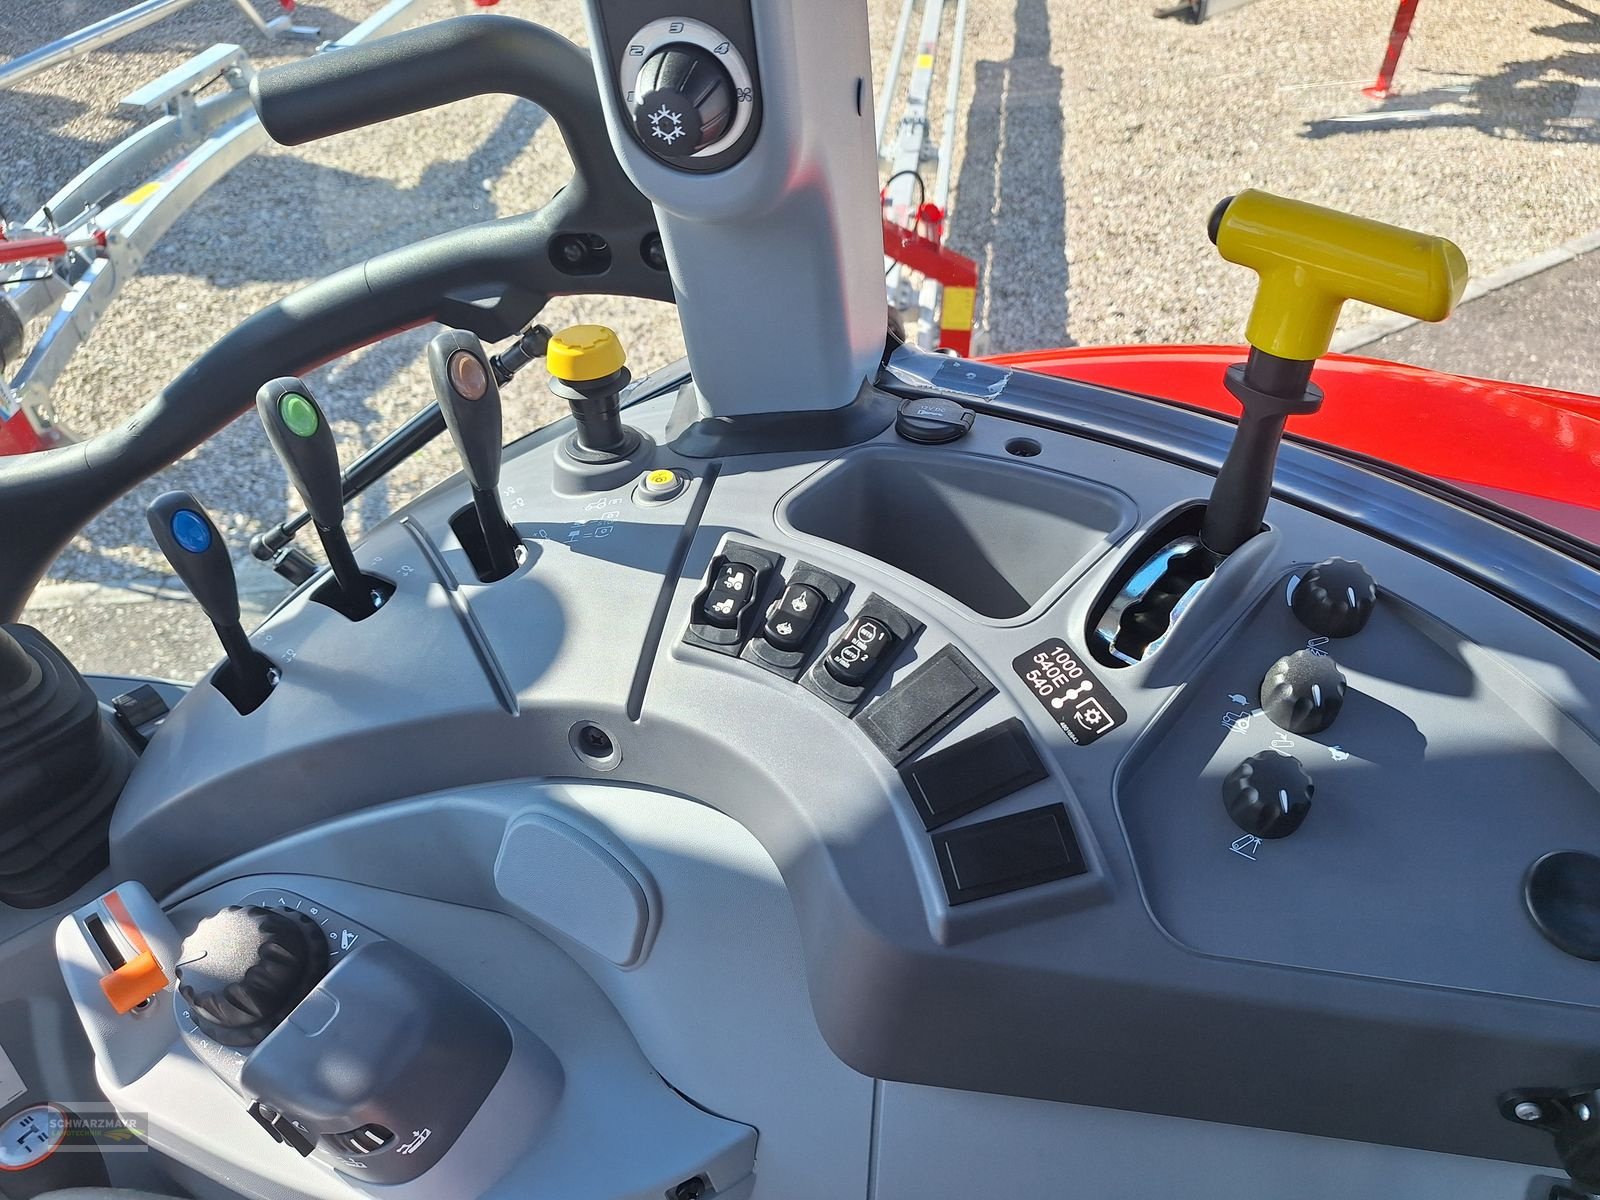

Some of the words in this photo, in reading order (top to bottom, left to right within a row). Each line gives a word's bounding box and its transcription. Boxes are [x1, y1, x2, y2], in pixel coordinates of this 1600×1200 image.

[669, 22, 684, 33] 3
[629, 45, 644, 56] 2
[714, 42, 729, 54] 4
[726, 567, 733, 575] A
[878, 632, 885, 640] 1
[1051, 646, 1083, 679] 1000
[1033, 652, 1070, 688] 540E
[1026, 669, 1054, 696] 540
[278, 897, 286, 905] 7
[310, 907, 318, 915] 8
[182, 1010, 191, 1018] 3
[200, 1040, 209, 1049] 2
